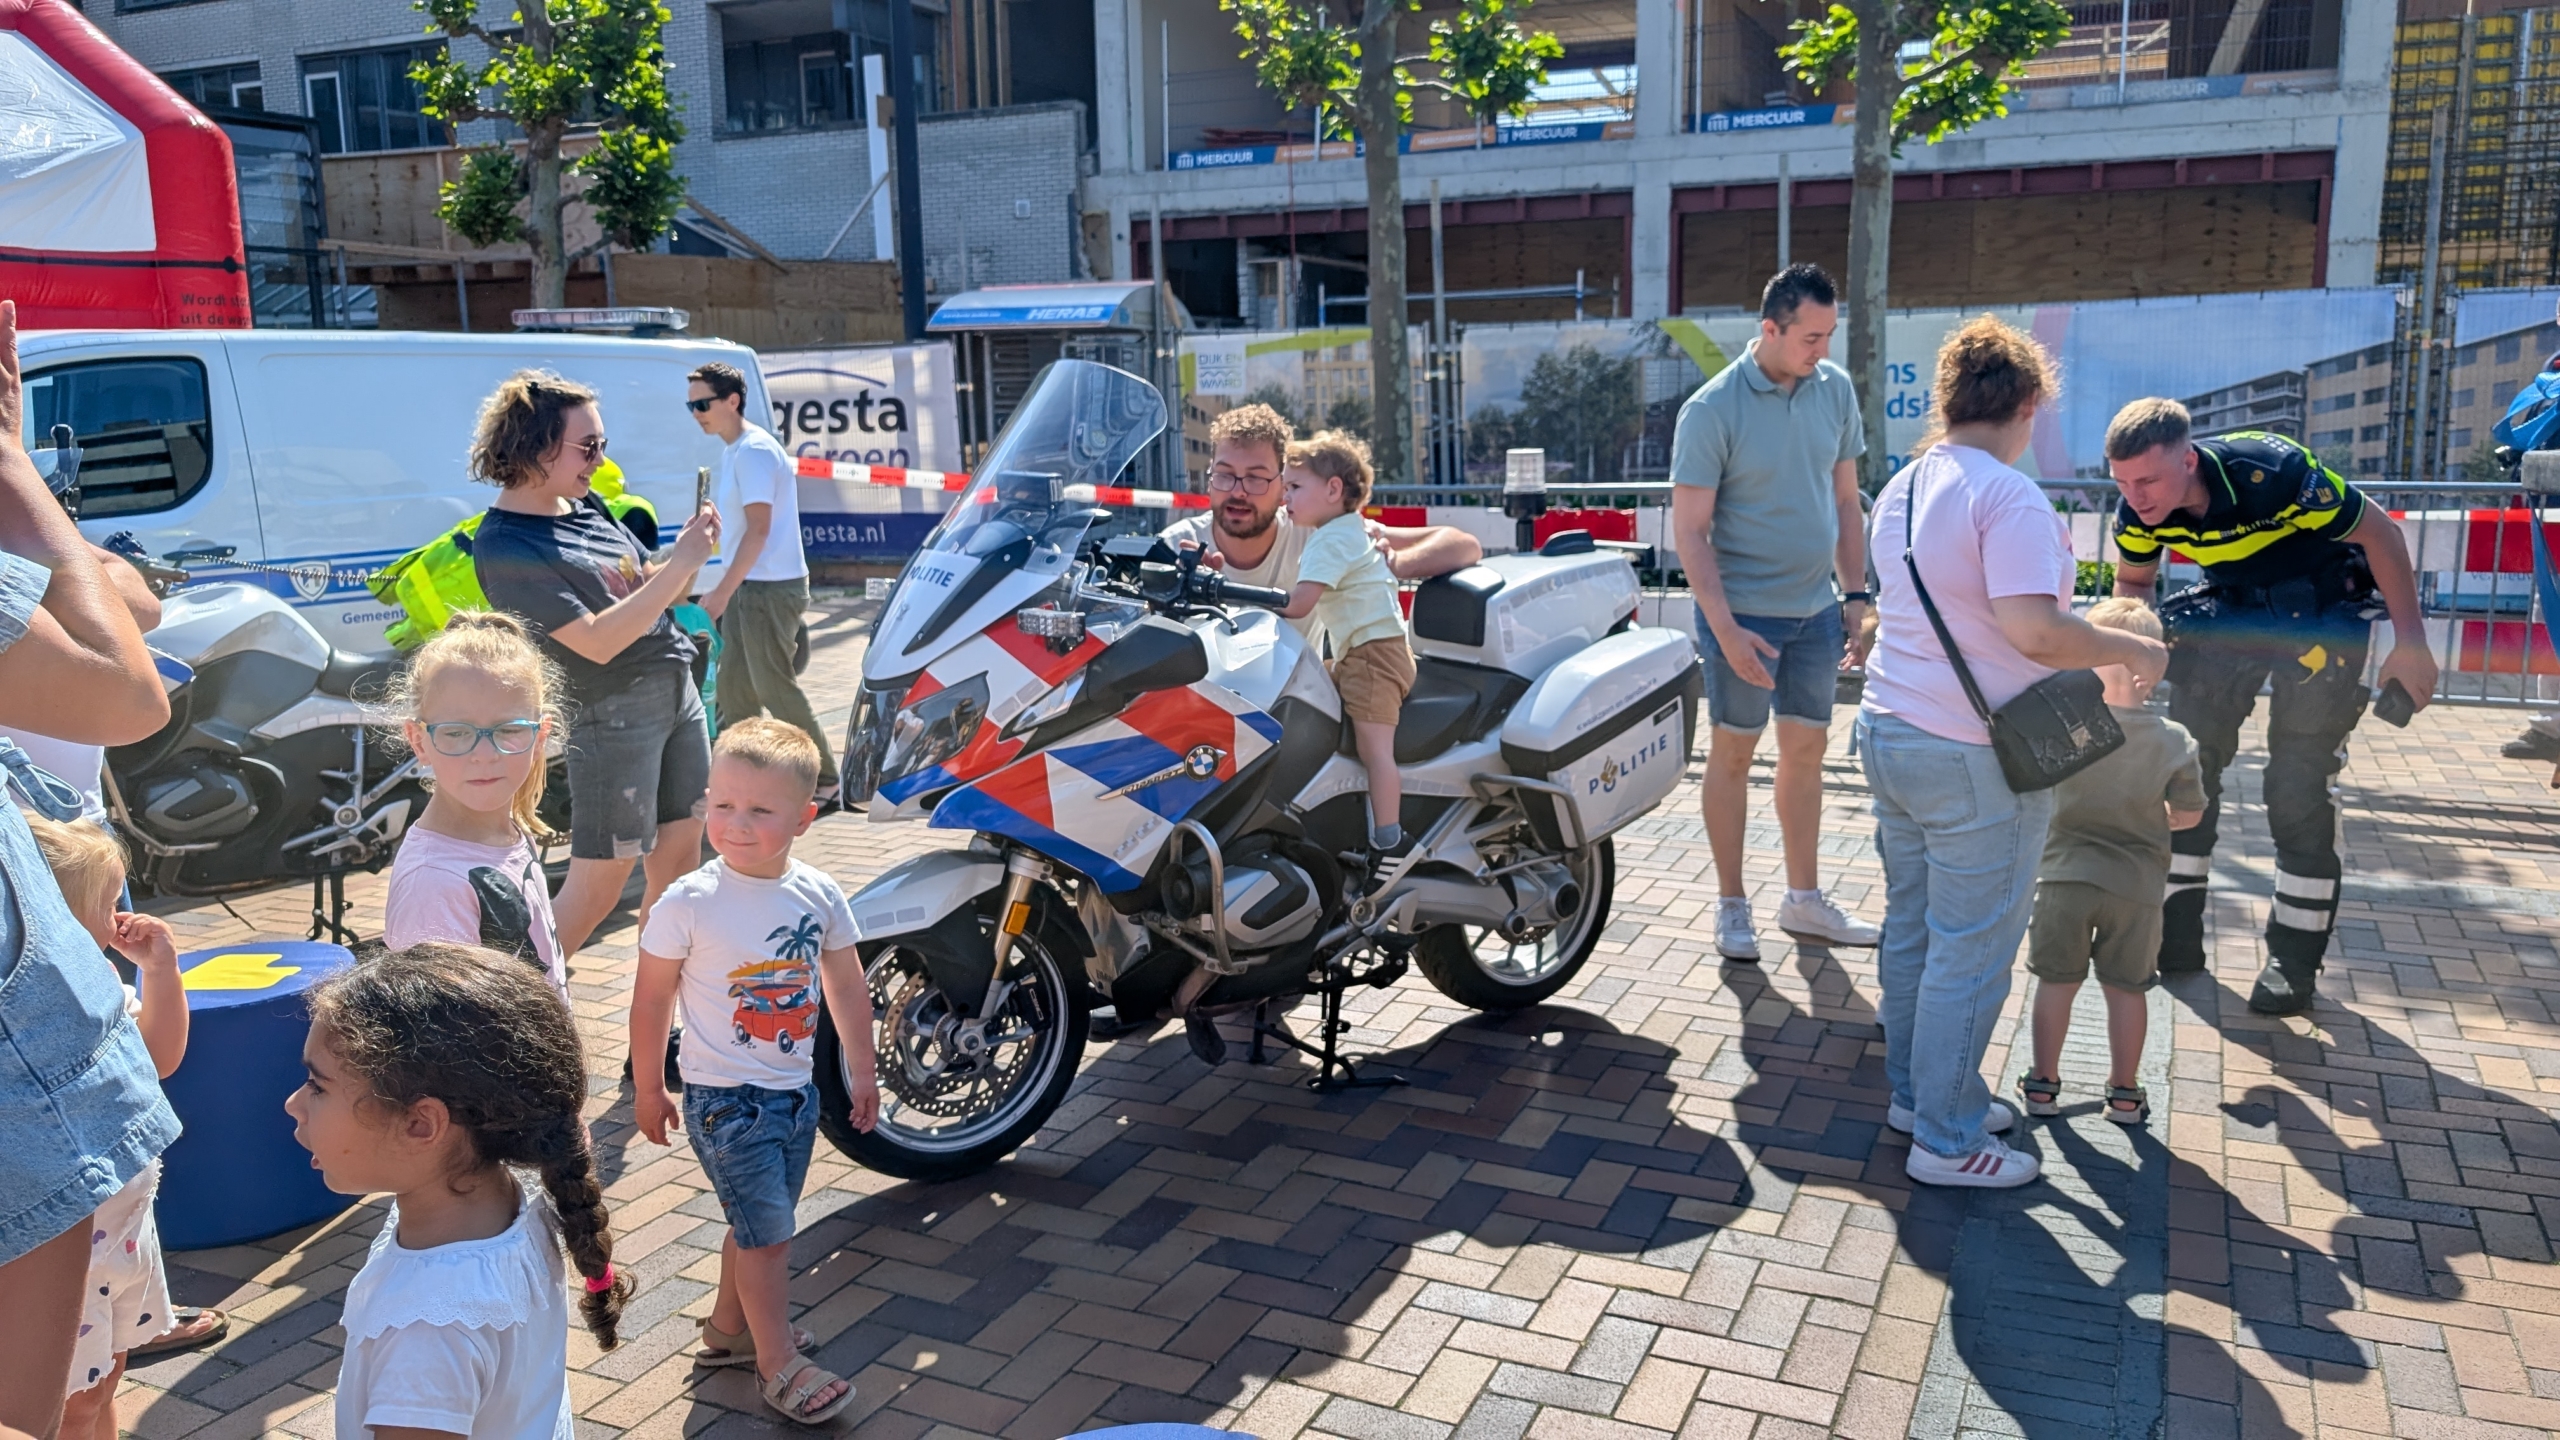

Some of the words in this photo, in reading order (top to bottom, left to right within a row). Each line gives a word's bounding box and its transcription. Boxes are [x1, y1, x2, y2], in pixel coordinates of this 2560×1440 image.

[1732, 111, 1806, 128] MERCUUR
[1511, 127, 1578, 142] MERCUUR
[1196, 151, 1254, 165] MERCUUR
[1027, 306, 1104, 321] HERAS
[801, 520, 886, 546] gesta.nl
[342, 608, 404, 625] Gemeent
[1588, 733, 1668, 796] POLITIE
